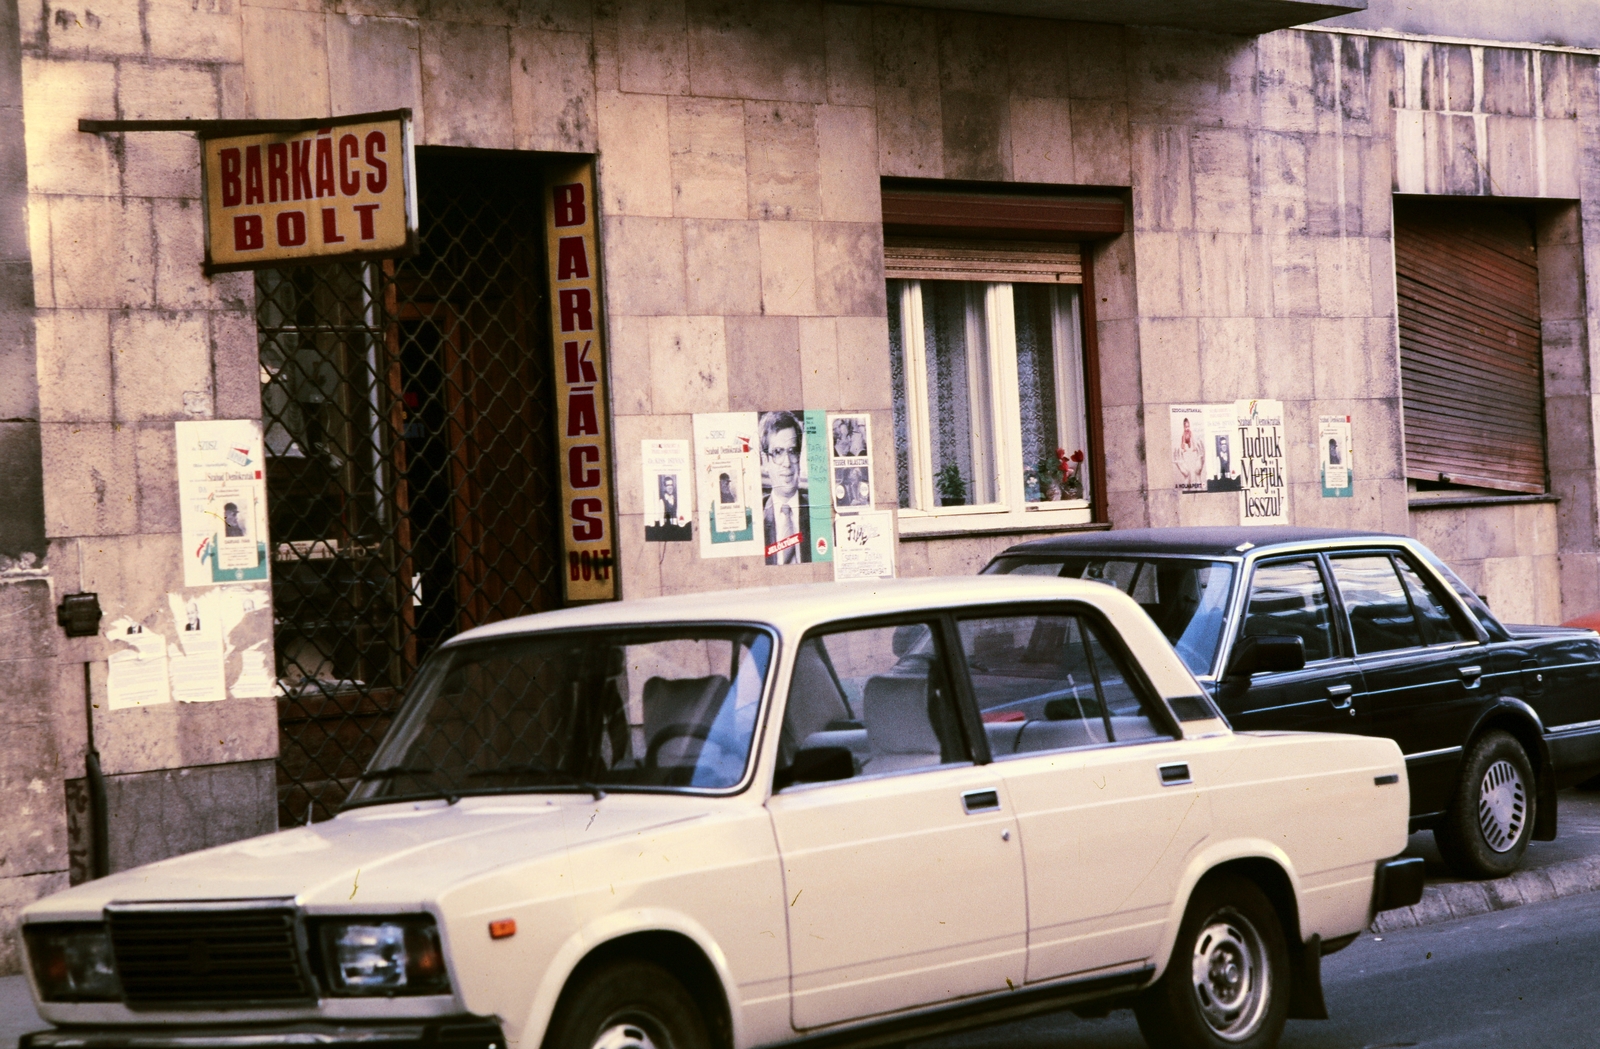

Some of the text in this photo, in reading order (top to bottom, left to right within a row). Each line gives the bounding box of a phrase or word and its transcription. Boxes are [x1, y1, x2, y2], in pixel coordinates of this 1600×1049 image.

[220, 127, 388, 208] BARKÁCS
[233, 204, 380, 251] BOLT
[553, 182, 603, 541] BARKÁCS
[1238, 427, 1282, 466] Tudjuk
[1240, 459, 1284, 493] Merjük
[1242, 488, 1284, 518] Tesszük
[568, 549, 611, 582] BOLT
